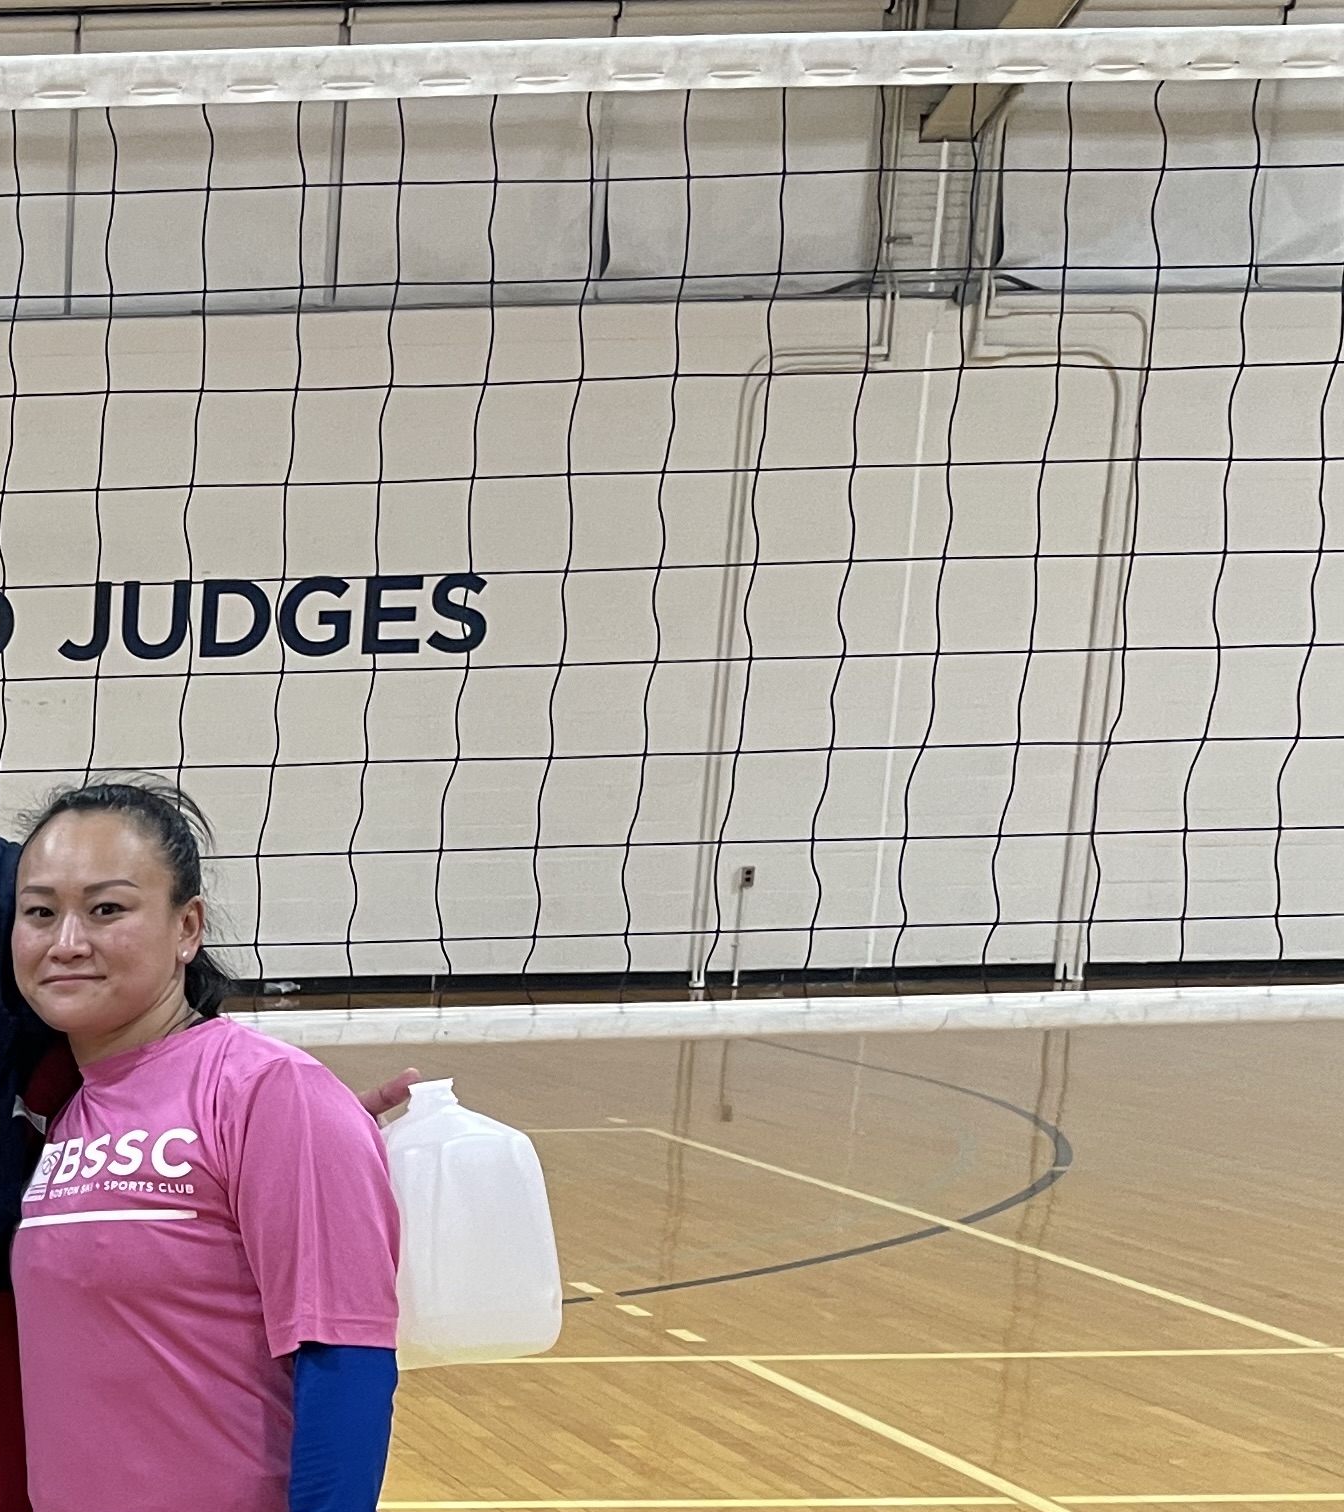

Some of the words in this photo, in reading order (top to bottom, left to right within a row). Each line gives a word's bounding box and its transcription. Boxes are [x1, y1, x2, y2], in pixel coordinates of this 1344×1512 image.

[58, 573, 488, 661] JUDGES
[52, 1127, 199, 1185] BSSC
[103, 1180, 154, 1193] SPORTS
[158, 1183, 194, 1194] CLUB
